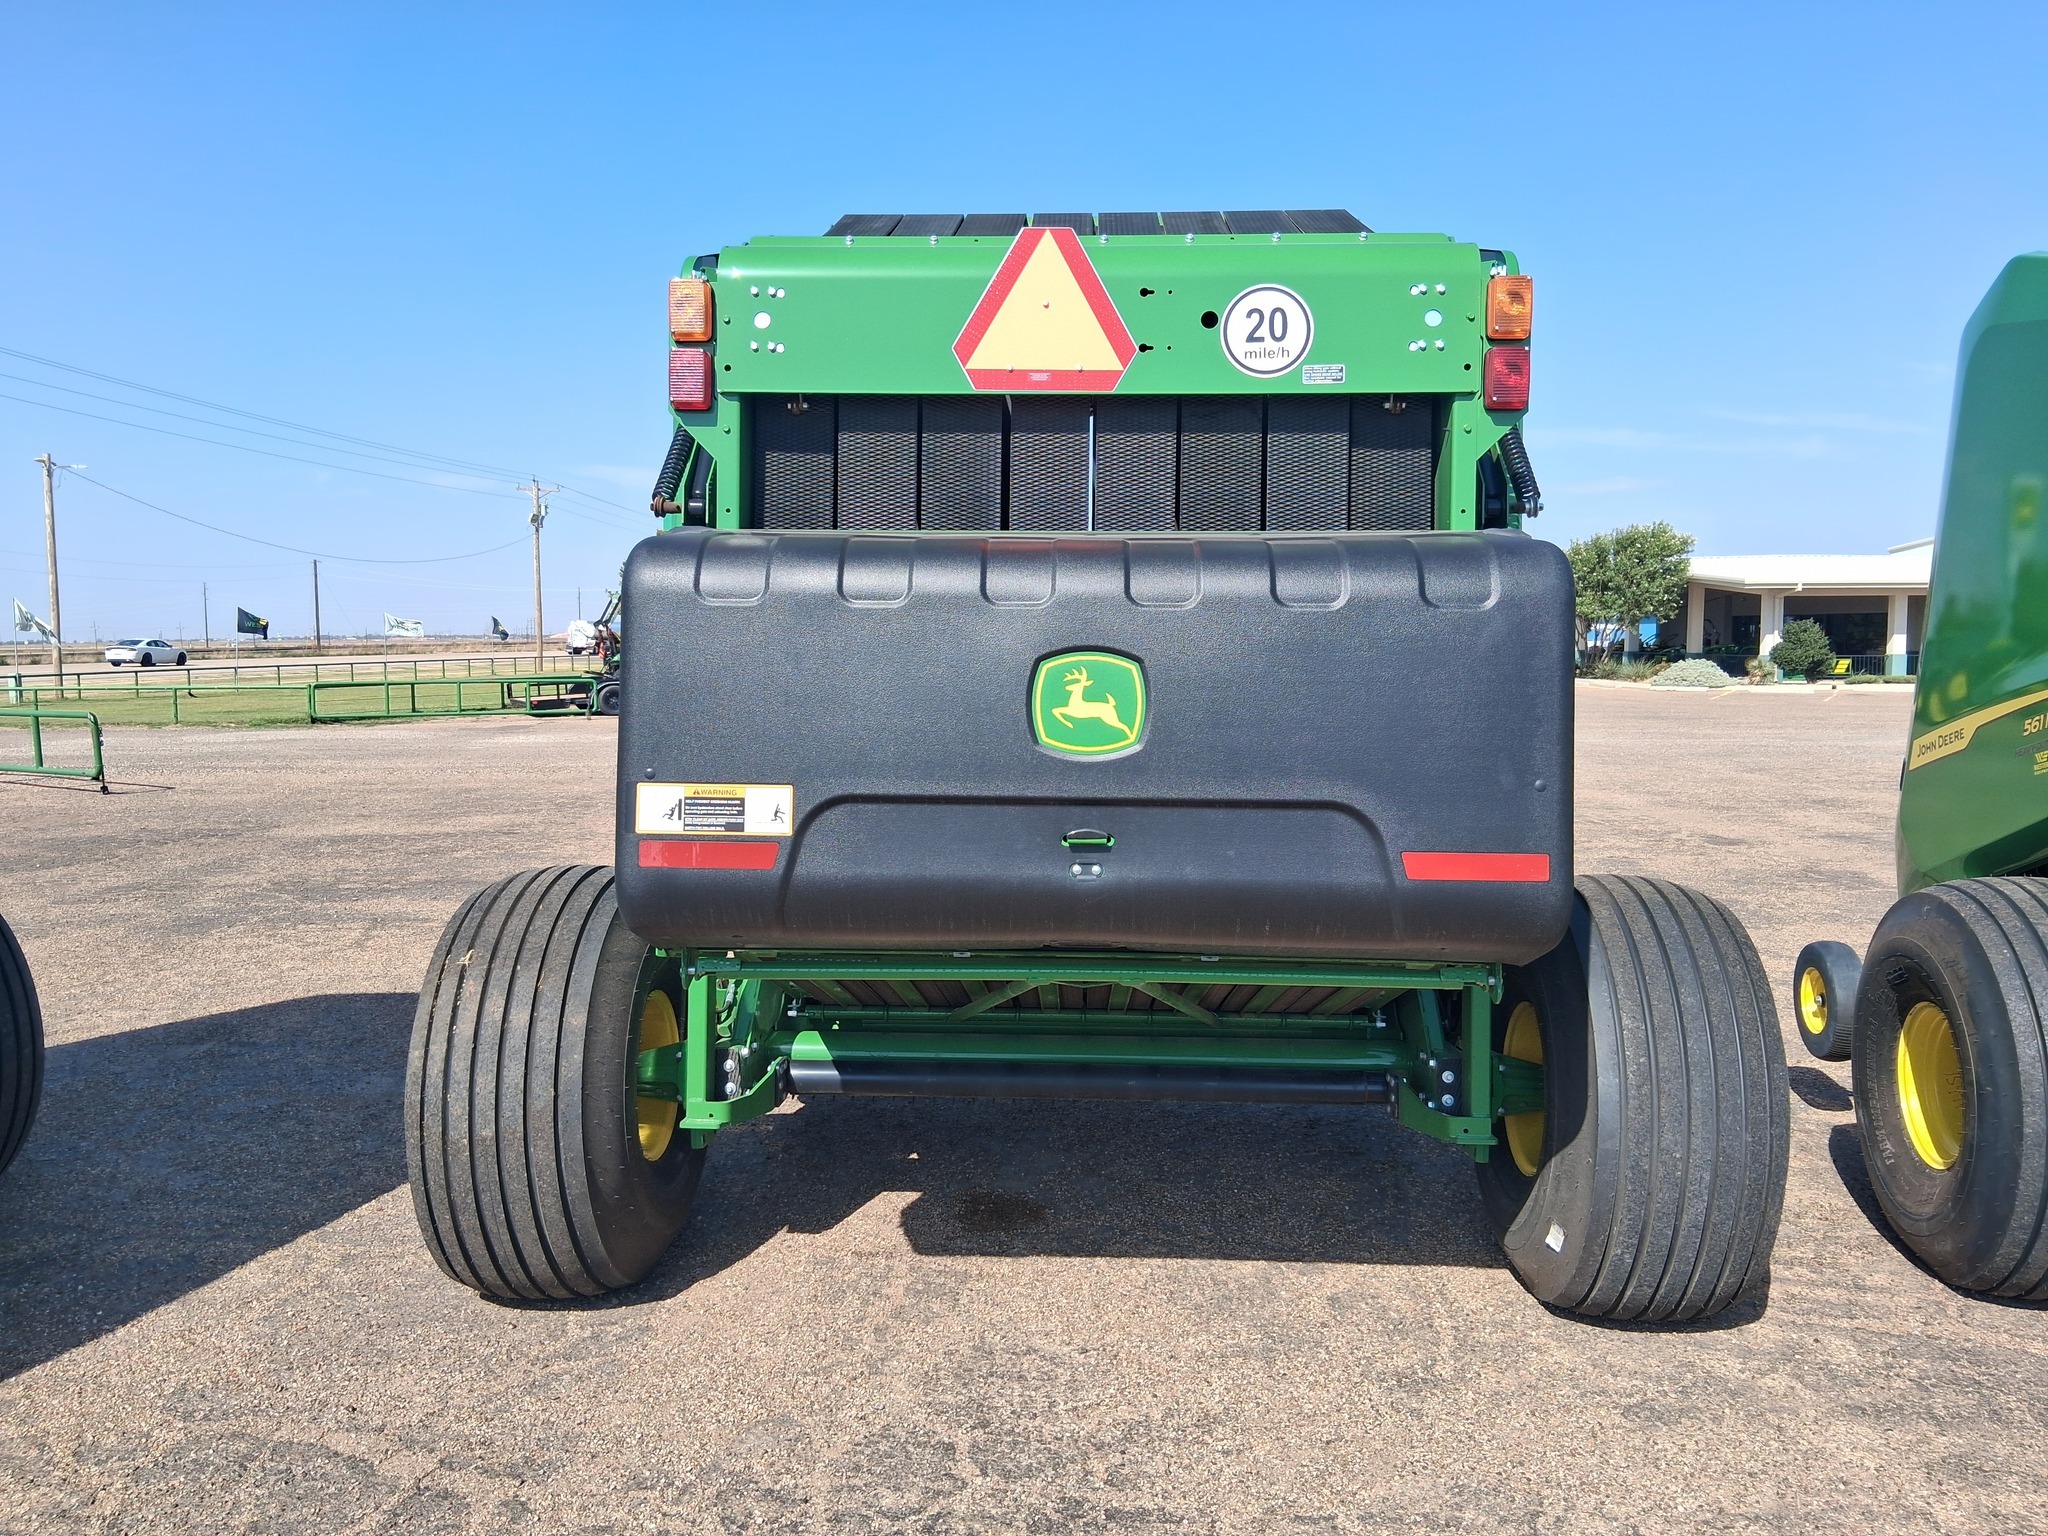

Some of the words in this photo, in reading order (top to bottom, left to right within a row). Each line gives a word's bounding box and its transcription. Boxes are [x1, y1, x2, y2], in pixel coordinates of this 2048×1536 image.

[1245, 307, 1288, 343] 20
[1244, 347, 1290, 359] mile/h
[1917, 740, 1937, 758] JOHN
[1938, 728, 1965, 749] DEERE
[700, 789, 738, 797] WARNING
